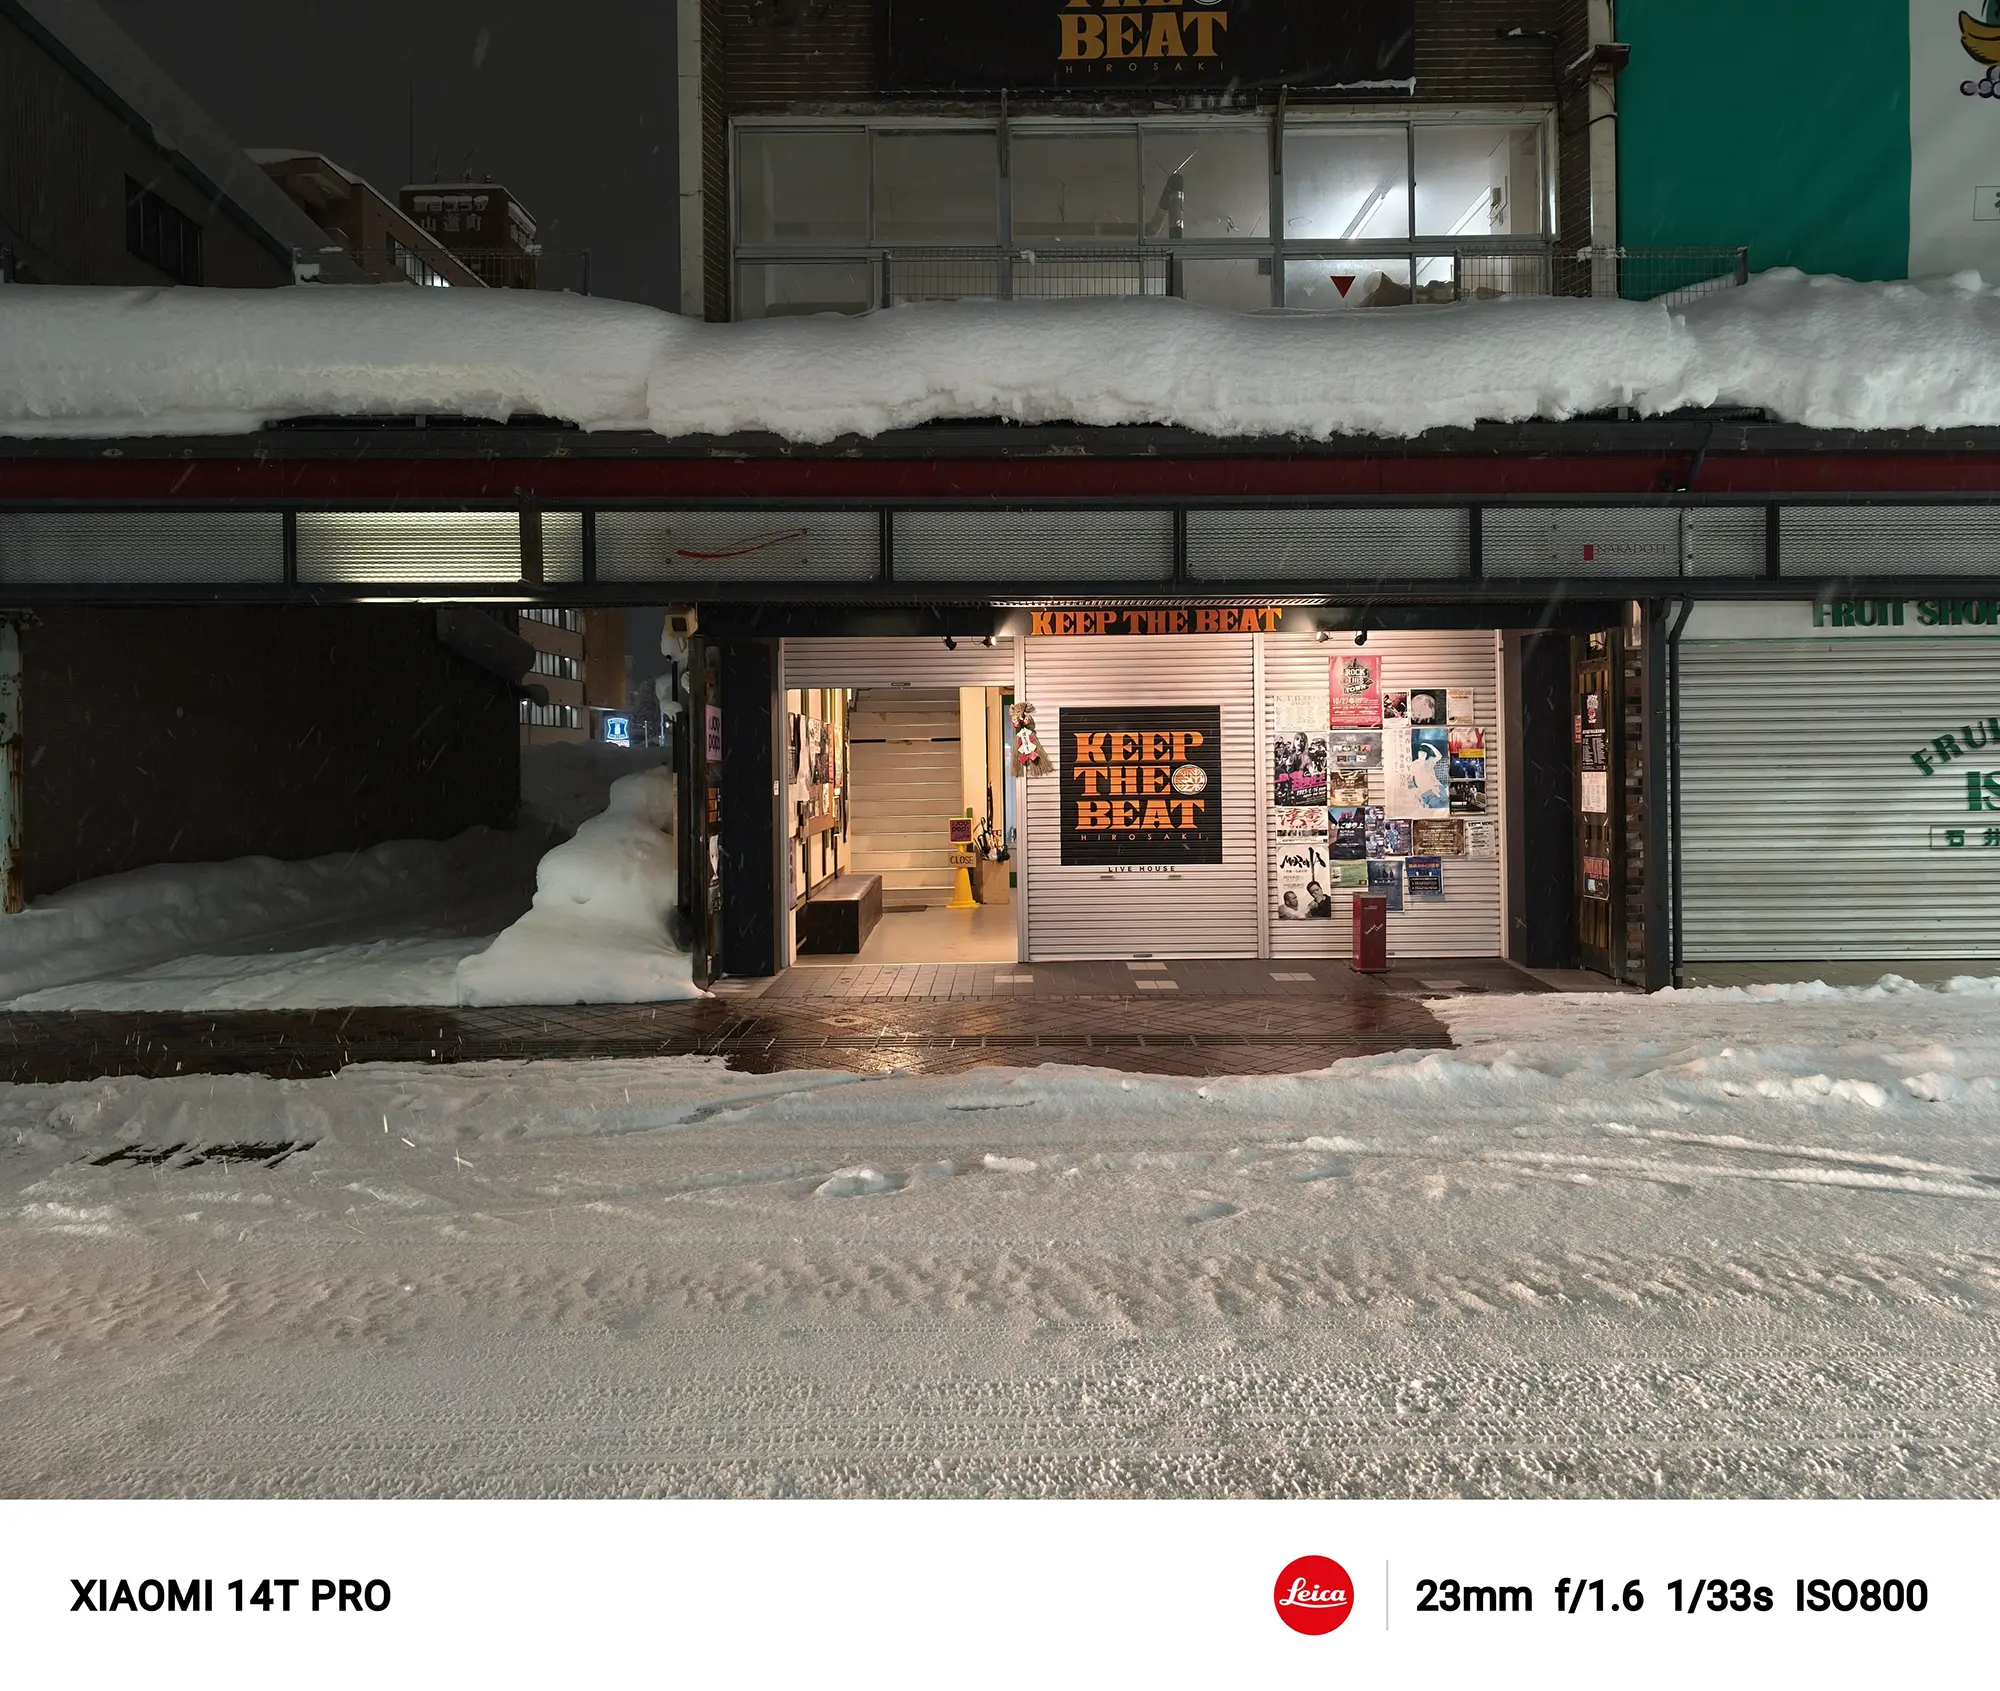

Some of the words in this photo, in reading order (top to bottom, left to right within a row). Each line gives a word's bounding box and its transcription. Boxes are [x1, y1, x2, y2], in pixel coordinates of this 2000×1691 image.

[1056, 11, 1228, 60] BEAT
[1065, 62, 1224, 74] HIROSAKI
[1030, 611, 1118, 635] KEEP
[1121, 610, 1189, 634] THE
[1194, 608, 1282, 633] BEAT
[1812, 599, 1910, 627] FRUIT
[1345, 668, 1366, 676] ROCK
[1345, 683, 1367, 693] TOWN
[1073, 731, 1204, 763] KEEP
[1073, 766, 1171, 796] THE
[1074, 799, 1205, 830] BEAT
[1080, 833, 1203, 841] HIROSAKI
[950, 856, 974, 864] CLOSE
